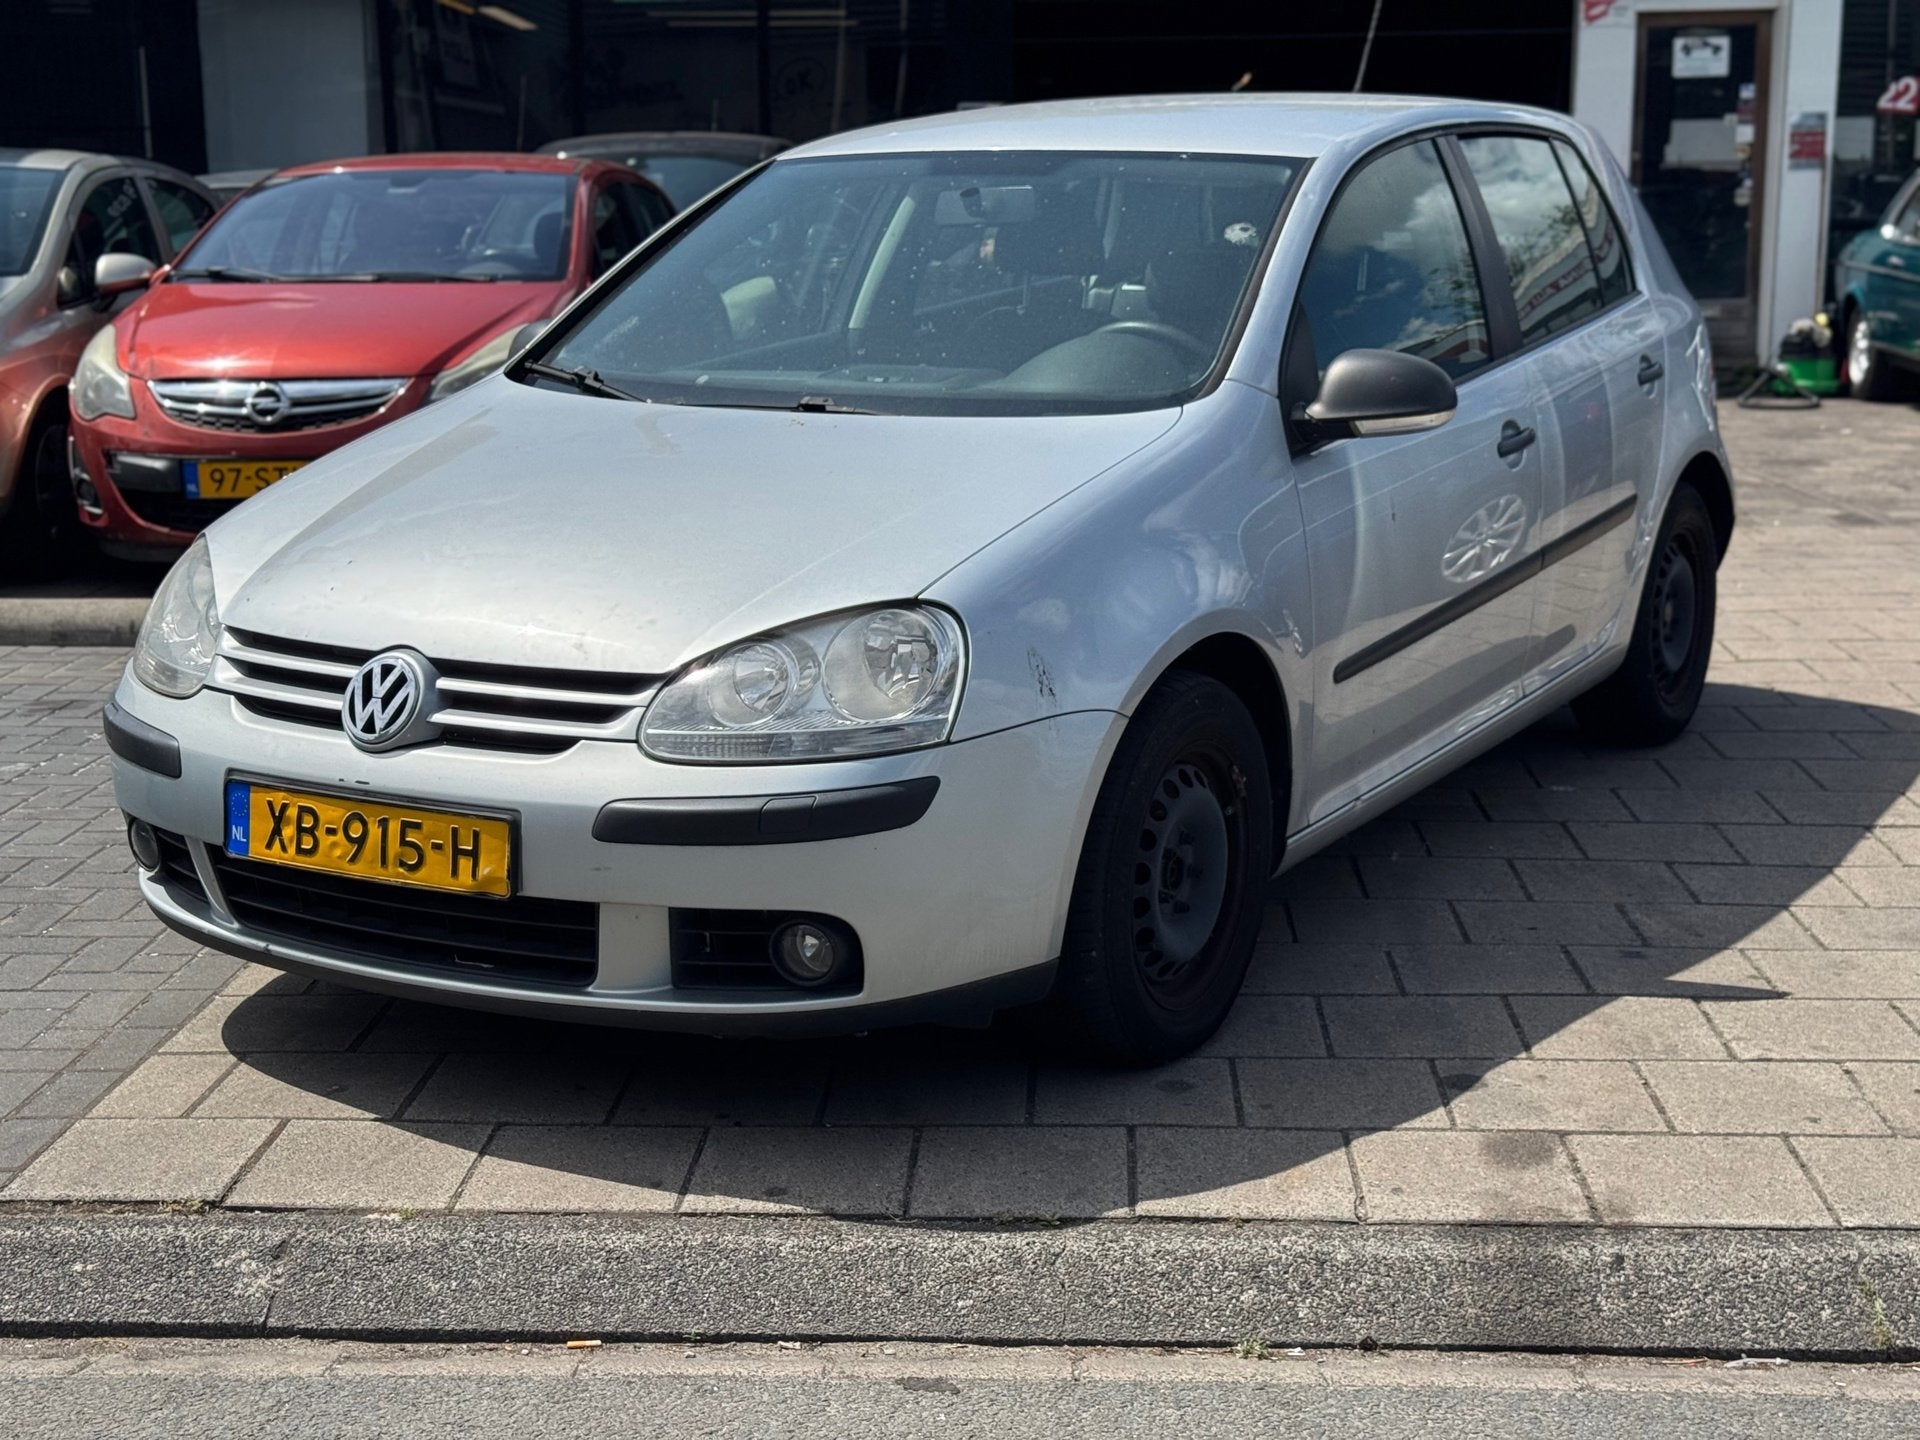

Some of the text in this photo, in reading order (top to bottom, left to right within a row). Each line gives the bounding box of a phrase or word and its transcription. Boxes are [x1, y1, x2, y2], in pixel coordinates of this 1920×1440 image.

[209, 466, 298, 492] 97-ST
[348, 659, 413, 738] VW
[231, 824, 248, 843] NL
[264, 798, 480, 882] XB-915-H
